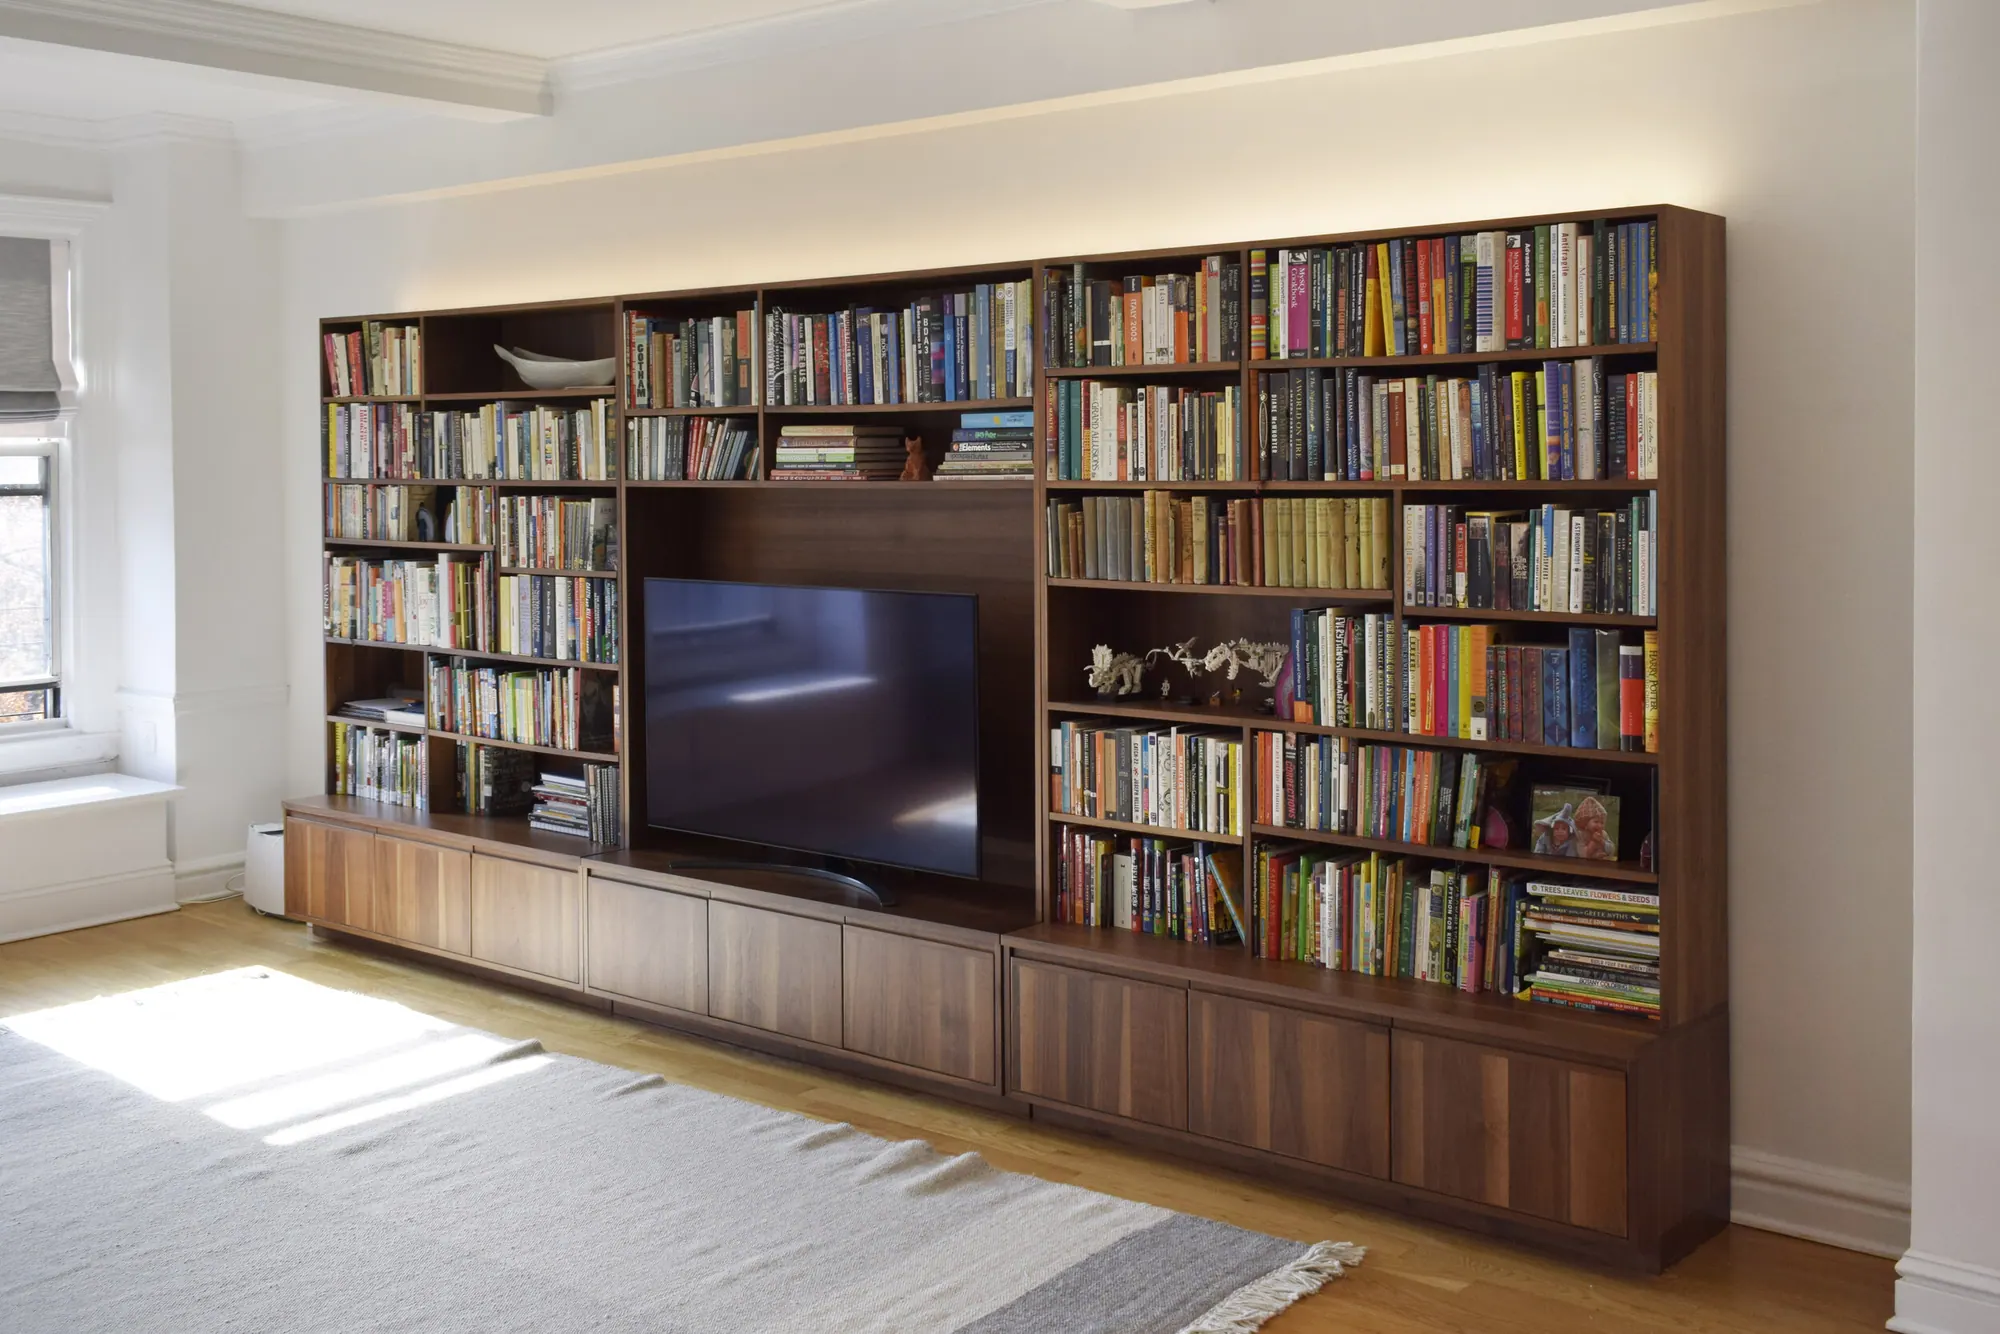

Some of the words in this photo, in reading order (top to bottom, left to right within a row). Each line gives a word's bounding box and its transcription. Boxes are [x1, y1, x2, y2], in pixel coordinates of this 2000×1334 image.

[1419, 255, 1427, 279] Power
[1560, 233, 1569, 276] Antifragile
[637, 344, 646, 397] GOTHAM
[1579, 375, 1587, 423] MOSQUITO
[1091, 402, 1100, 429] GRAND
[1296, 422, 1303, 435] ON
[962, 443, 991, 452] Elements
[1091, 432, 1100, 470] ALLUSIONS
[1649, 650, 1658, 678] HARRY
[1650, 680, 1658, 712] POTTER
[1286, 761, 1295, 819] CORRECTIONS
[1590, 892, 1621, 900] FLOWERS
[1628, 895, 1650, 903] SEEDS
